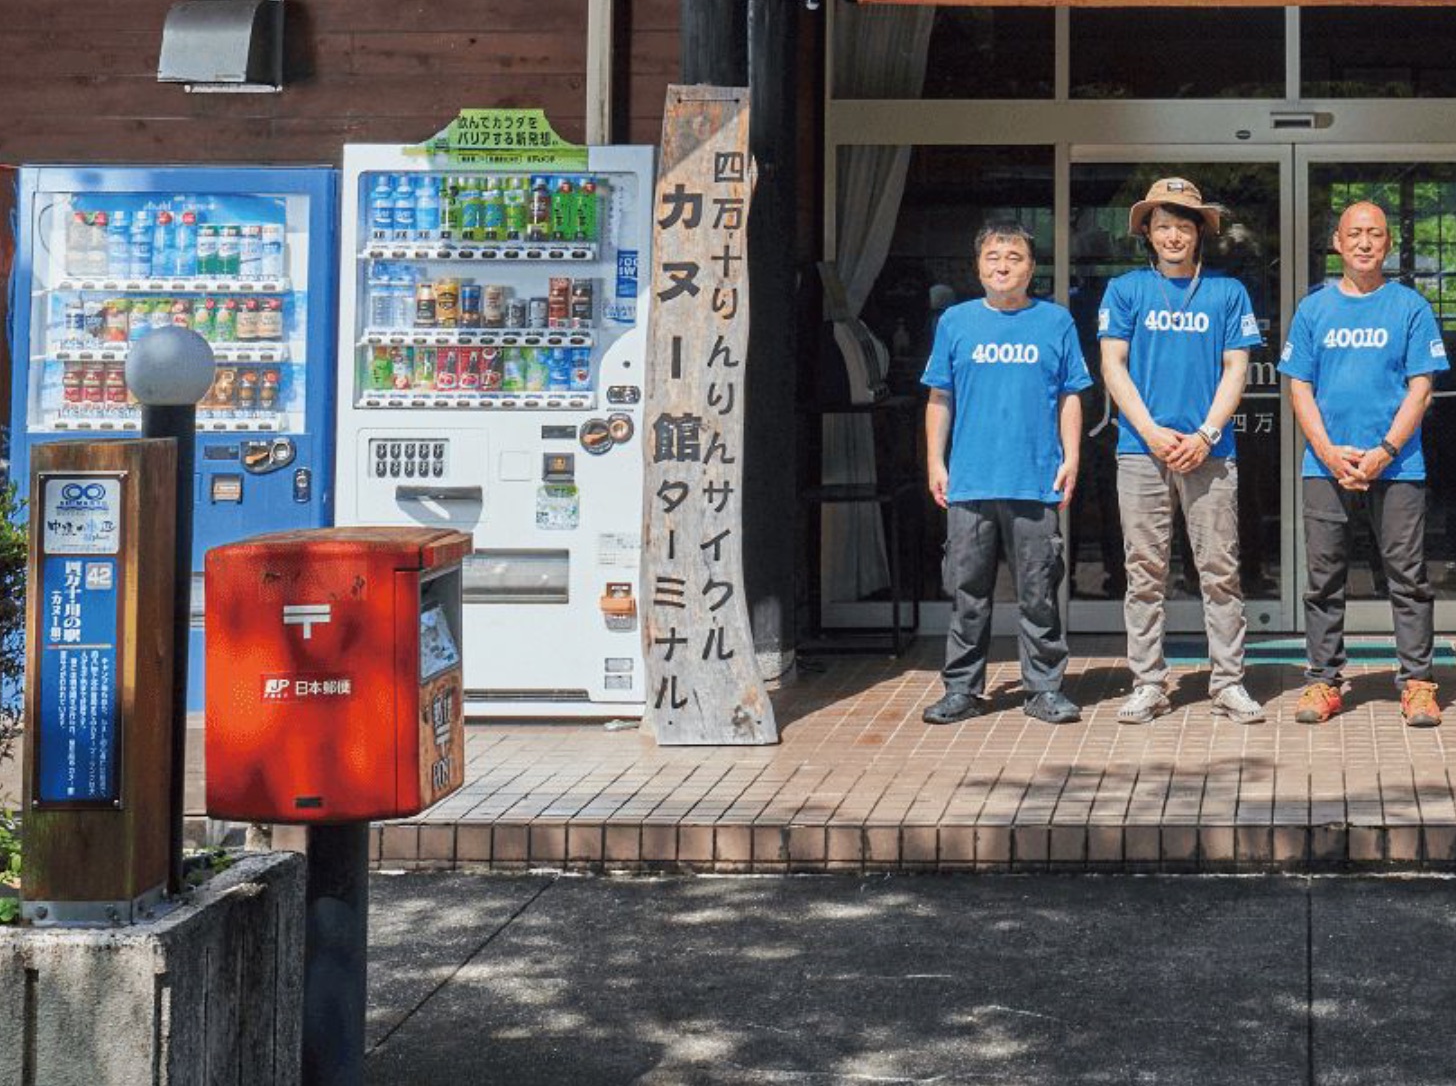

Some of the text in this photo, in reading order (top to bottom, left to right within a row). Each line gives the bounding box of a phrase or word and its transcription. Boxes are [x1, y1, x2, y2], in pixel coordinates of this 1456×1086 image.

[1144, 309, 1210, 334] 40010
[1323, 327, 1388, 348] 40010
[972, 343, 1038, 364] 40010
[698, 151, 746, 663] 四万十りんりんサイクル
[87, 567, 112, 587] 42
[295, 679, 352, 695] 日本郵便
